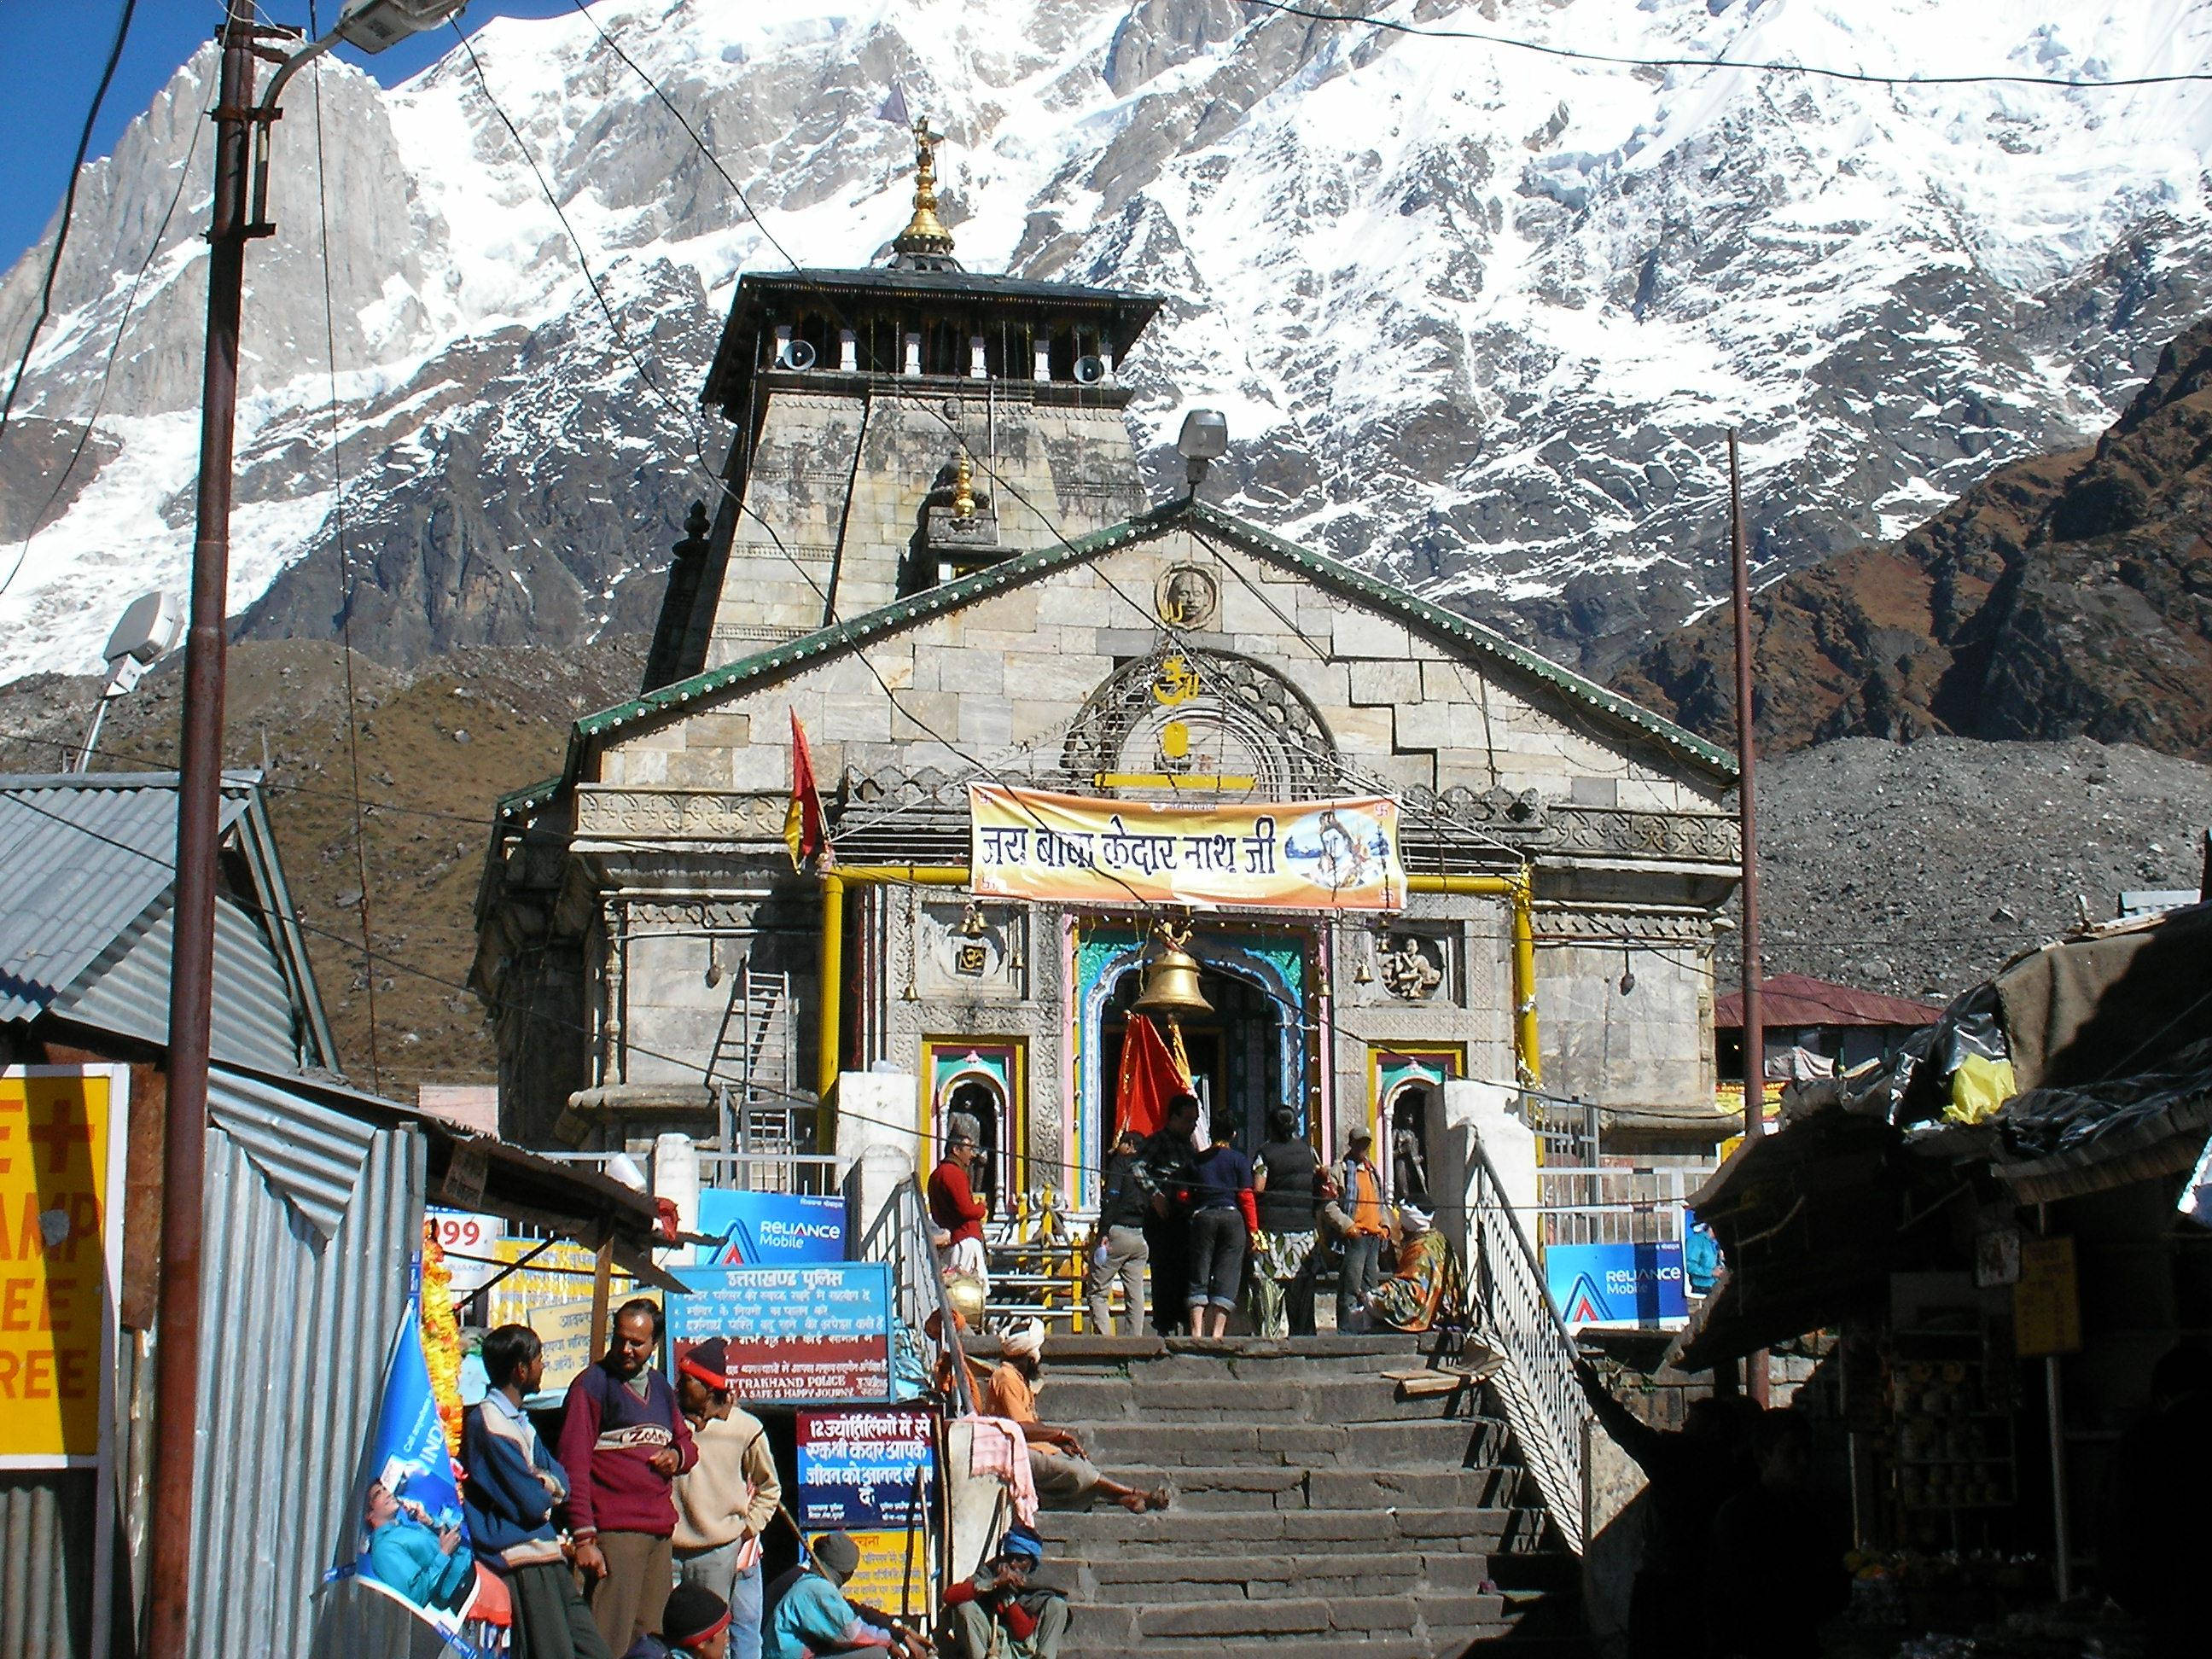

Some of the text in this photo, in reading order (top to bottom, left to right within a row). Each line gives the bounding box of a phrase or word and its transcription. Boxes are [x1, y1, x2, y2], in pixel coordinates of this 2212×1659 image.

[981, 815, 1277, 876] जय बाबा केदार नाथ जी
[760, 1220, 841, 1239] RELIANCE
[760, 1233, 804, 1249] Mobile
[800, 1269, 844, 1291] पुलिस
[1605, 1266, 1681, 1283] RELIANCE
[1606, 1282, 1648, 1294] Mobile
